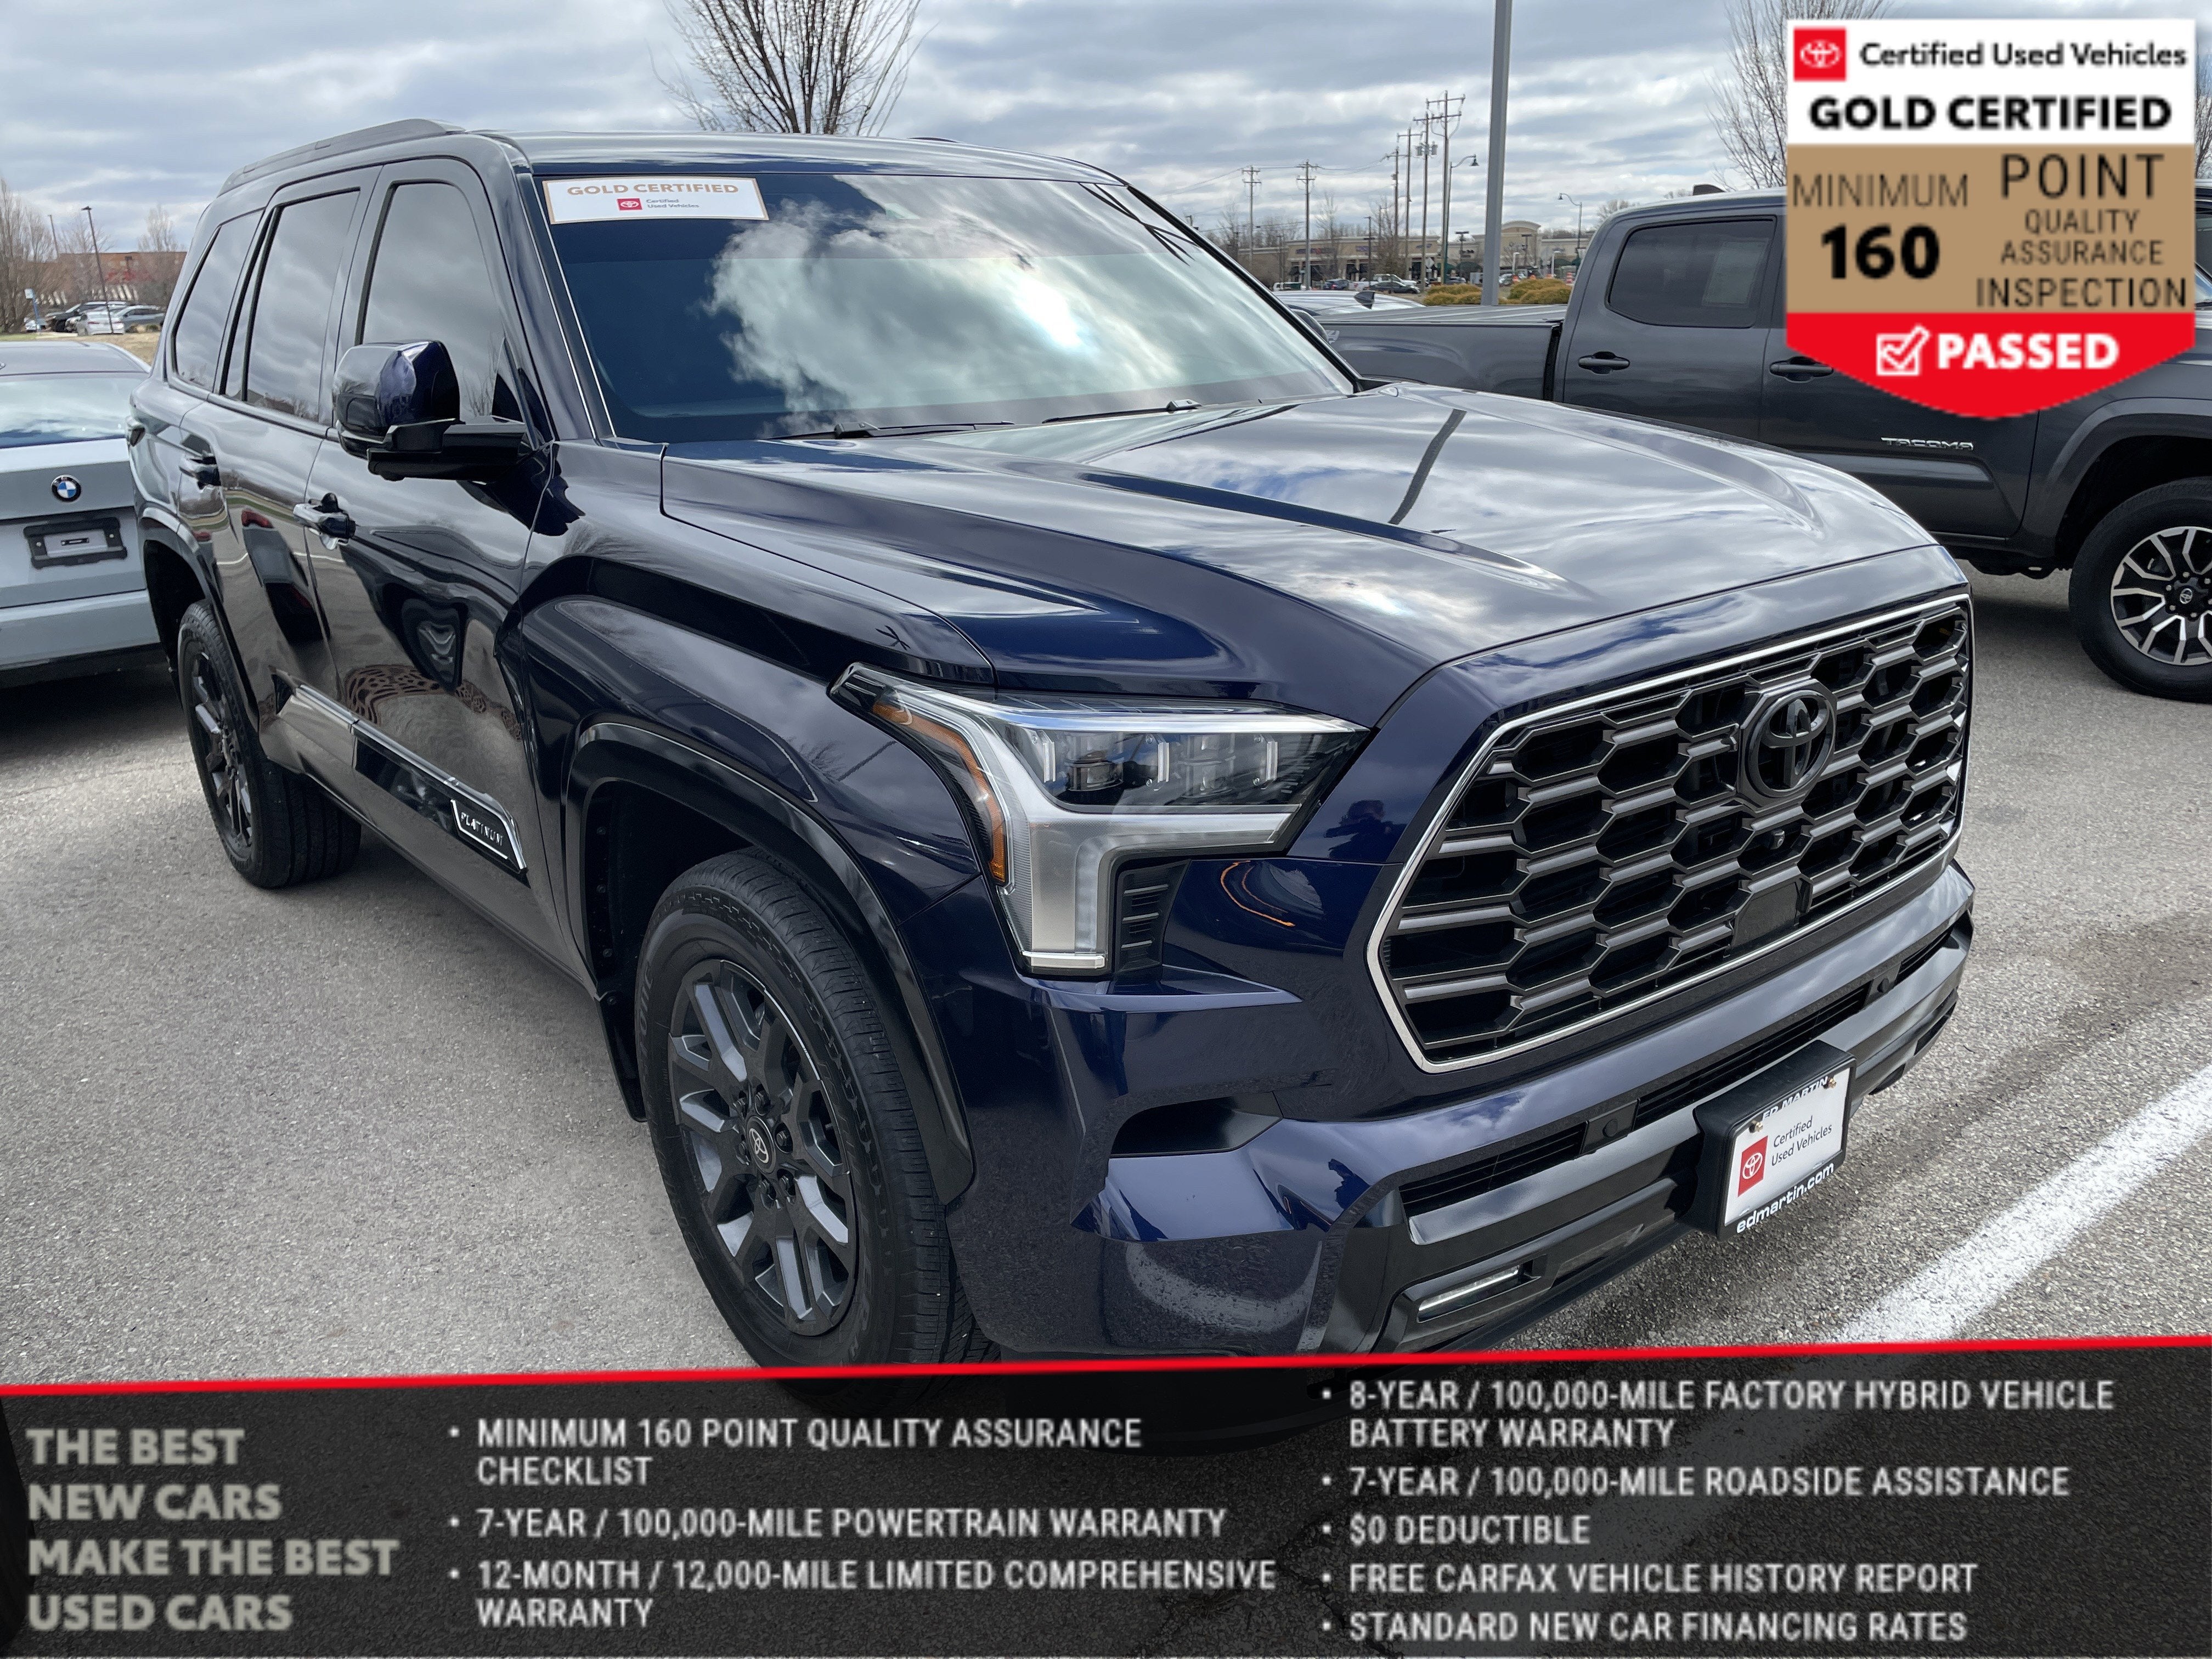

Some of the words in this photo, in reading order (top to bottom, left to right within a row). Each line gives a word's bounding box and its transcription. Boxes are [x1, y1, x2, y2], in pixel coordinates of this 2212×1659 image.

[567, 184, 628, 195] GOLD
[633, 183, 738, 193] CERTIFIED
[1771, 1143, 1794, 1166] Used
[1796, 1124, 1832, 1150] Vehicles
[1773, 1115, 1813, 1148] Certified
[1736, 1163, 1834, 1233] edmartin.com
